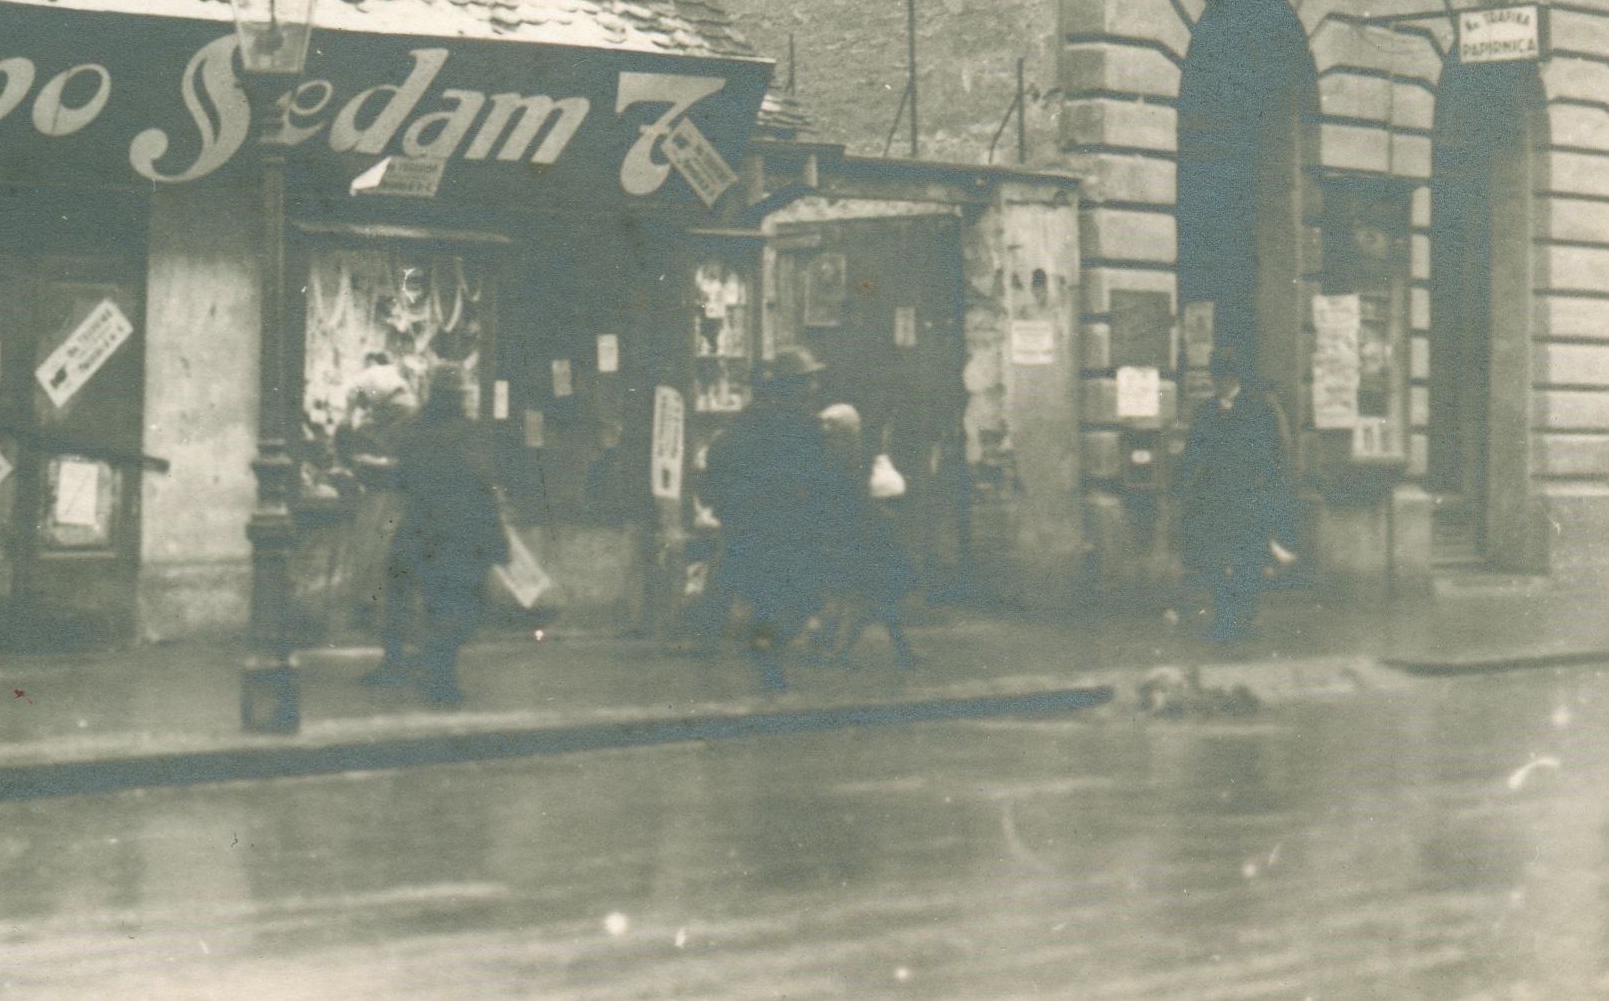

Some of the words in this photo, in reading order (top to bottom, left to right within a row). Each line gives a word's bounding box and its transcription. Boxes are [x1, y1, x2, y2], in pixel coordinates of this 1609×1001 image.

[1462, 38, 1536, 57] PAPIRNICA
[128, 32, 590, 183] Sedam
[614, 70, 726, 196] 7
